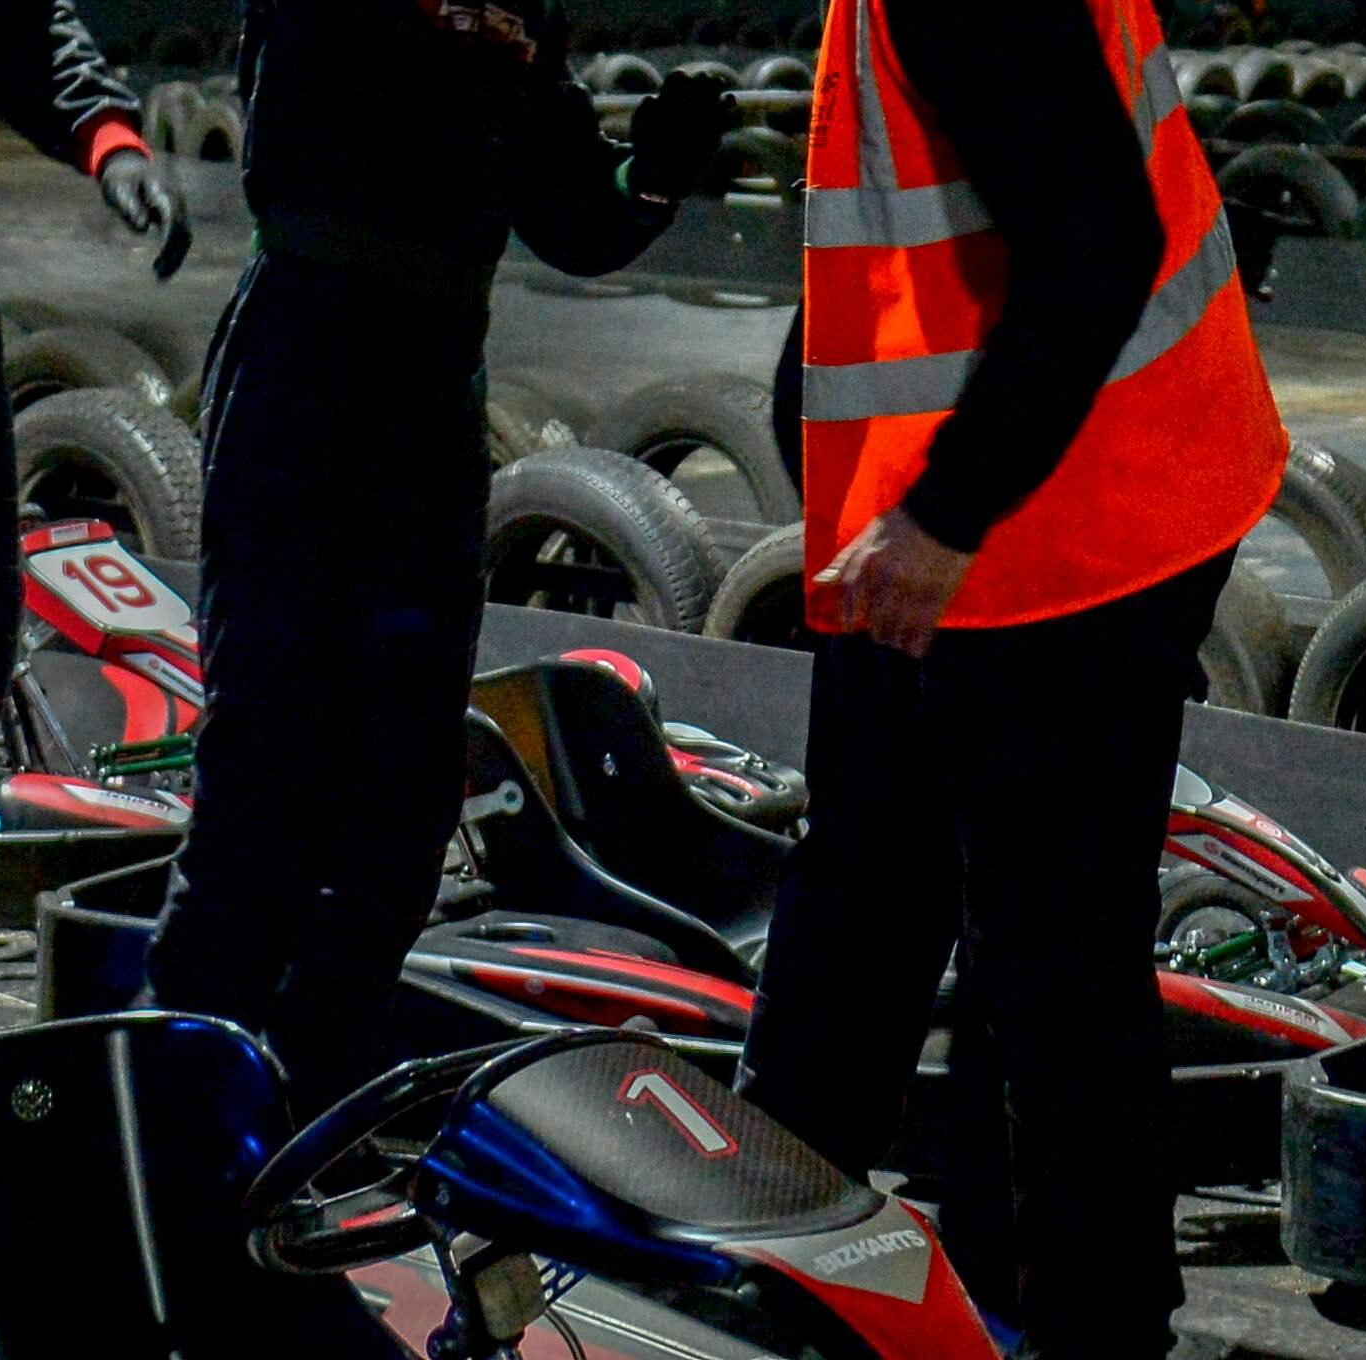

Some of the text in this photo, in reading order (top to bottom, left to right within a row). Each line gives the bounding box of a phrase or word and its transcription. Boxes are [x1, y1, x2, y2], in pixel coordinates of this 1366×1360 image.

[62, 554, 156, 613] 19
[616, 1068, 739, 1160] 1
[811, 1229, 927, 1277] BIZKARTS
